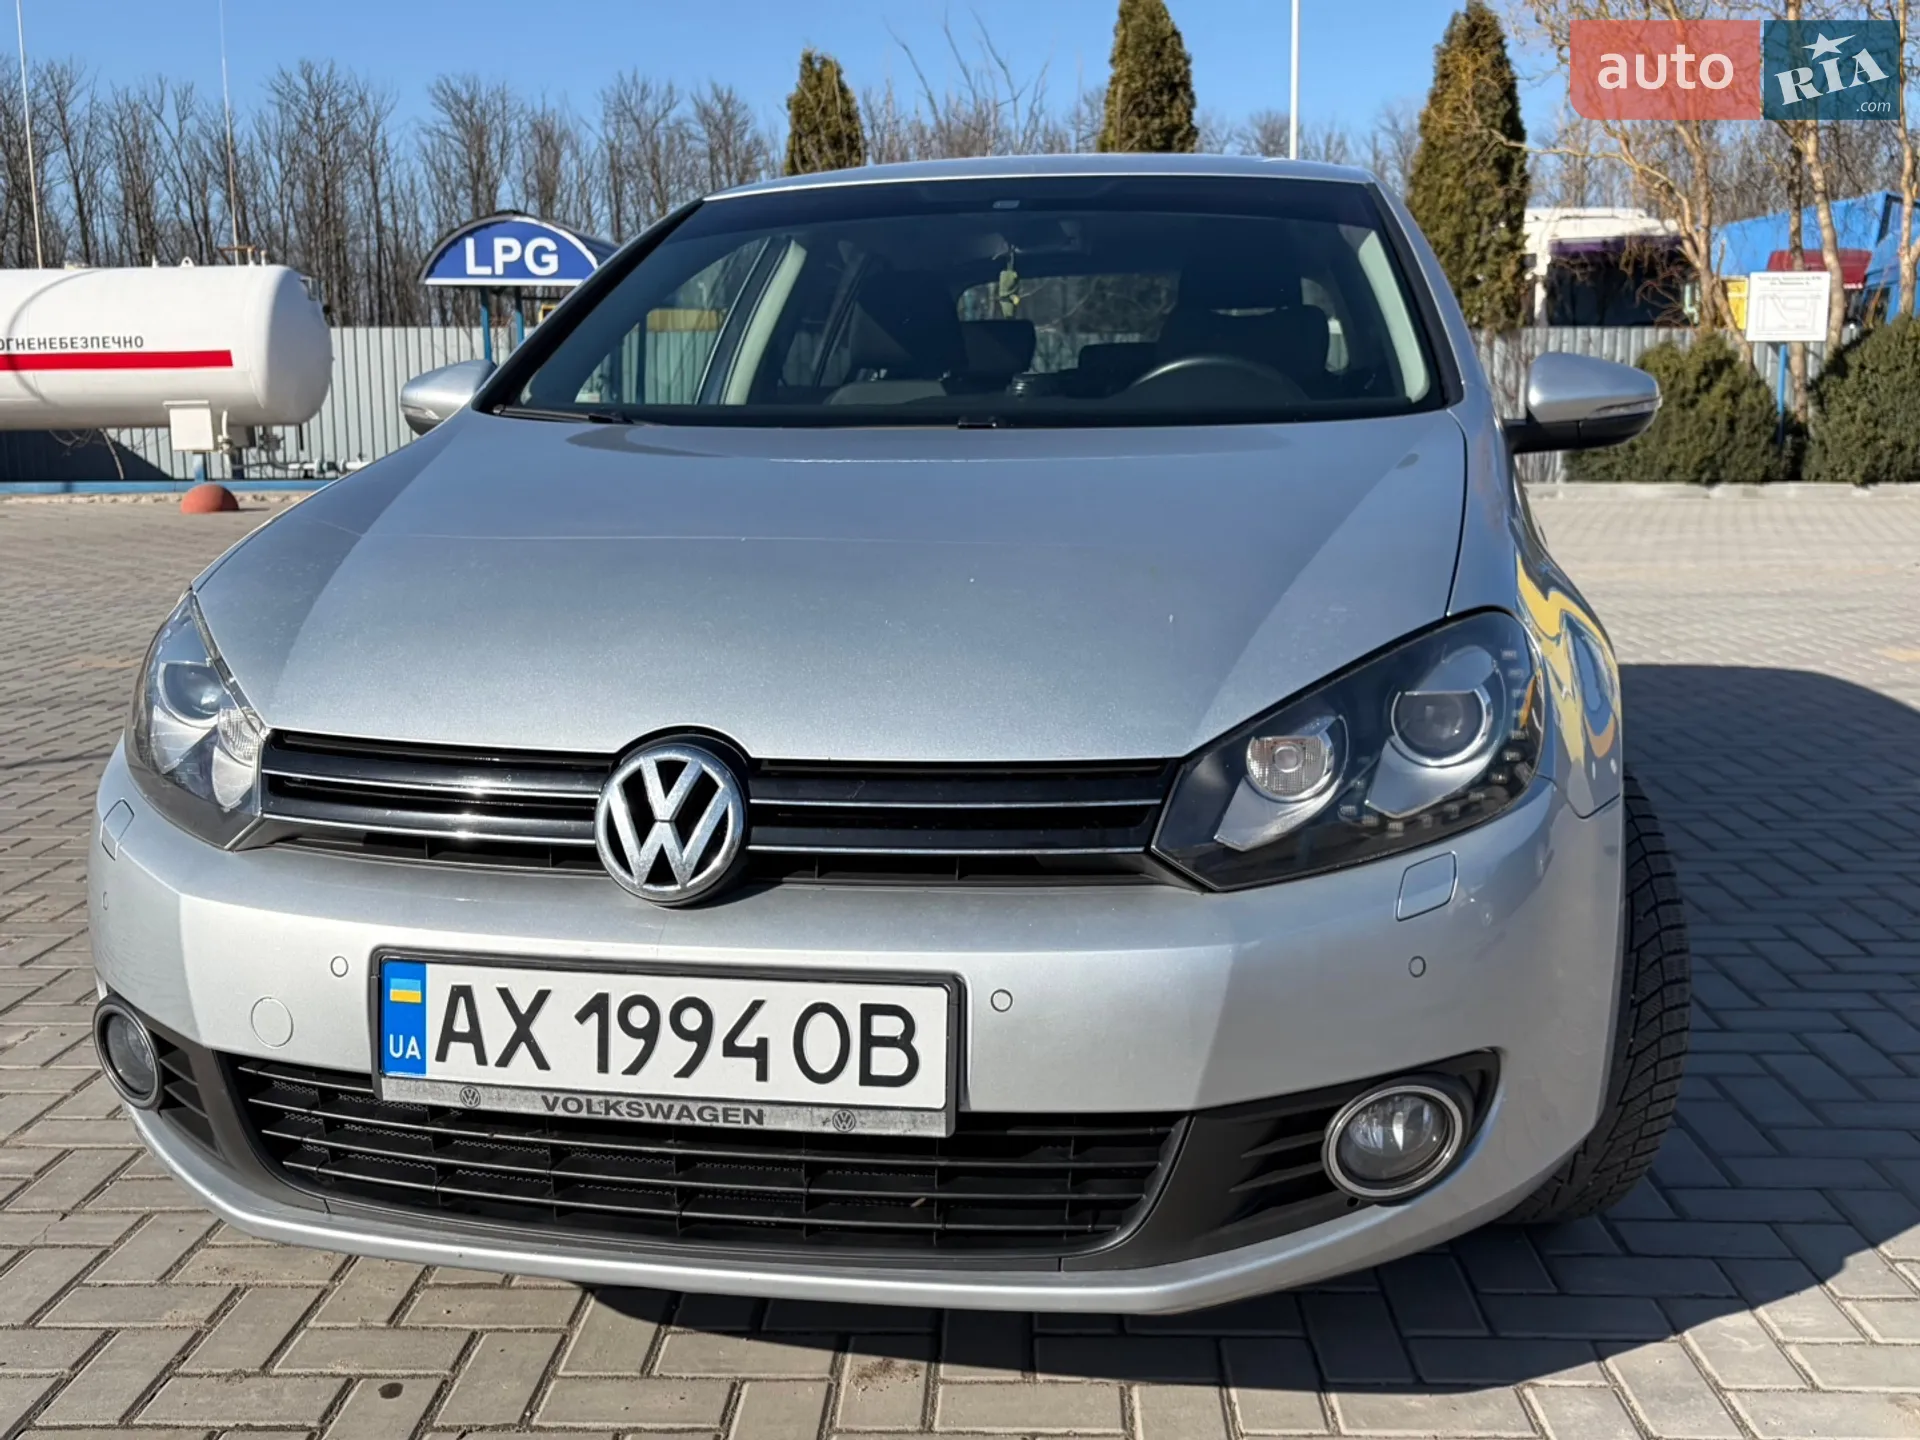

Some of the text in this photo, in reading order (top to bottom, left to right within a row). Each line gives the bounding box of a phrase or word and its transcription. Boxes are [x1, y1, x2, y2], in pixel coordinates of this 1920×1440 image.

[465, 237, 559, 276] LPG
[389, 1034, 422, 1060] UA
[434, 984, 920, 1088] AX 1994 OB
[541, 1095, 764, 1126] VOLKSWAGEN
